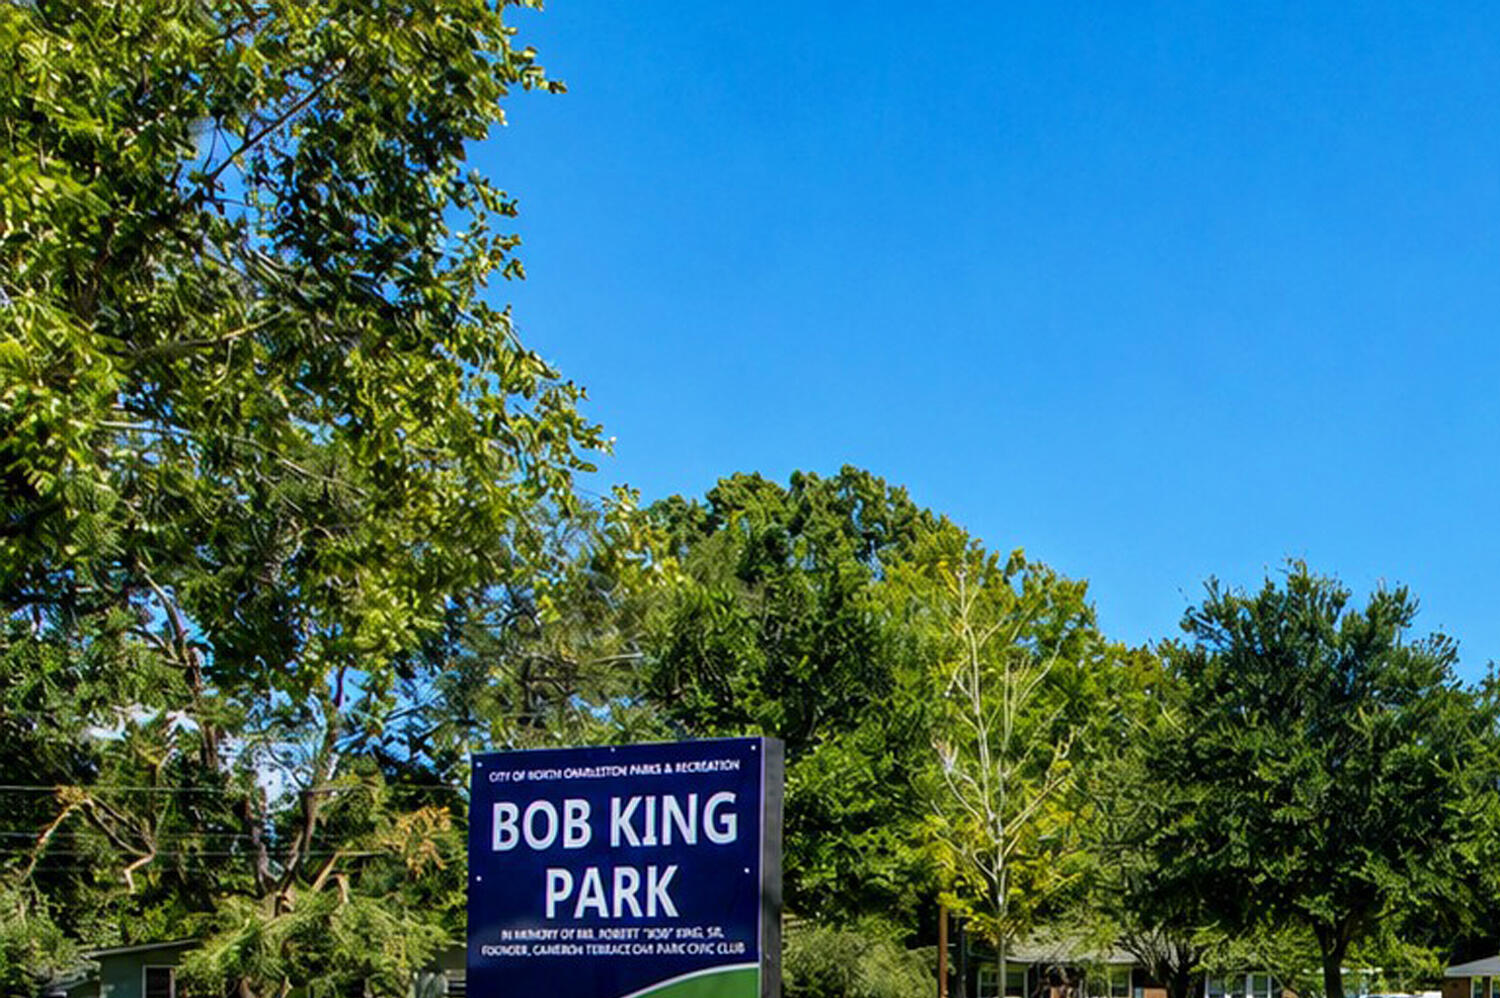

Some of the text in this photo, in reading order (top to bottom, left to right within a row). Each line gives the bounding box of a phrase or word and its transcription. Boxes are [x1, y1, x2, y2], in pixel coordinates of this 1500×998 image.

[489, 770, 510, 782] CITY
[512, 770, 525, 782] OF
[492, 791, 738, 851] BOB KING
[545, 865, 679, 918] PARK
